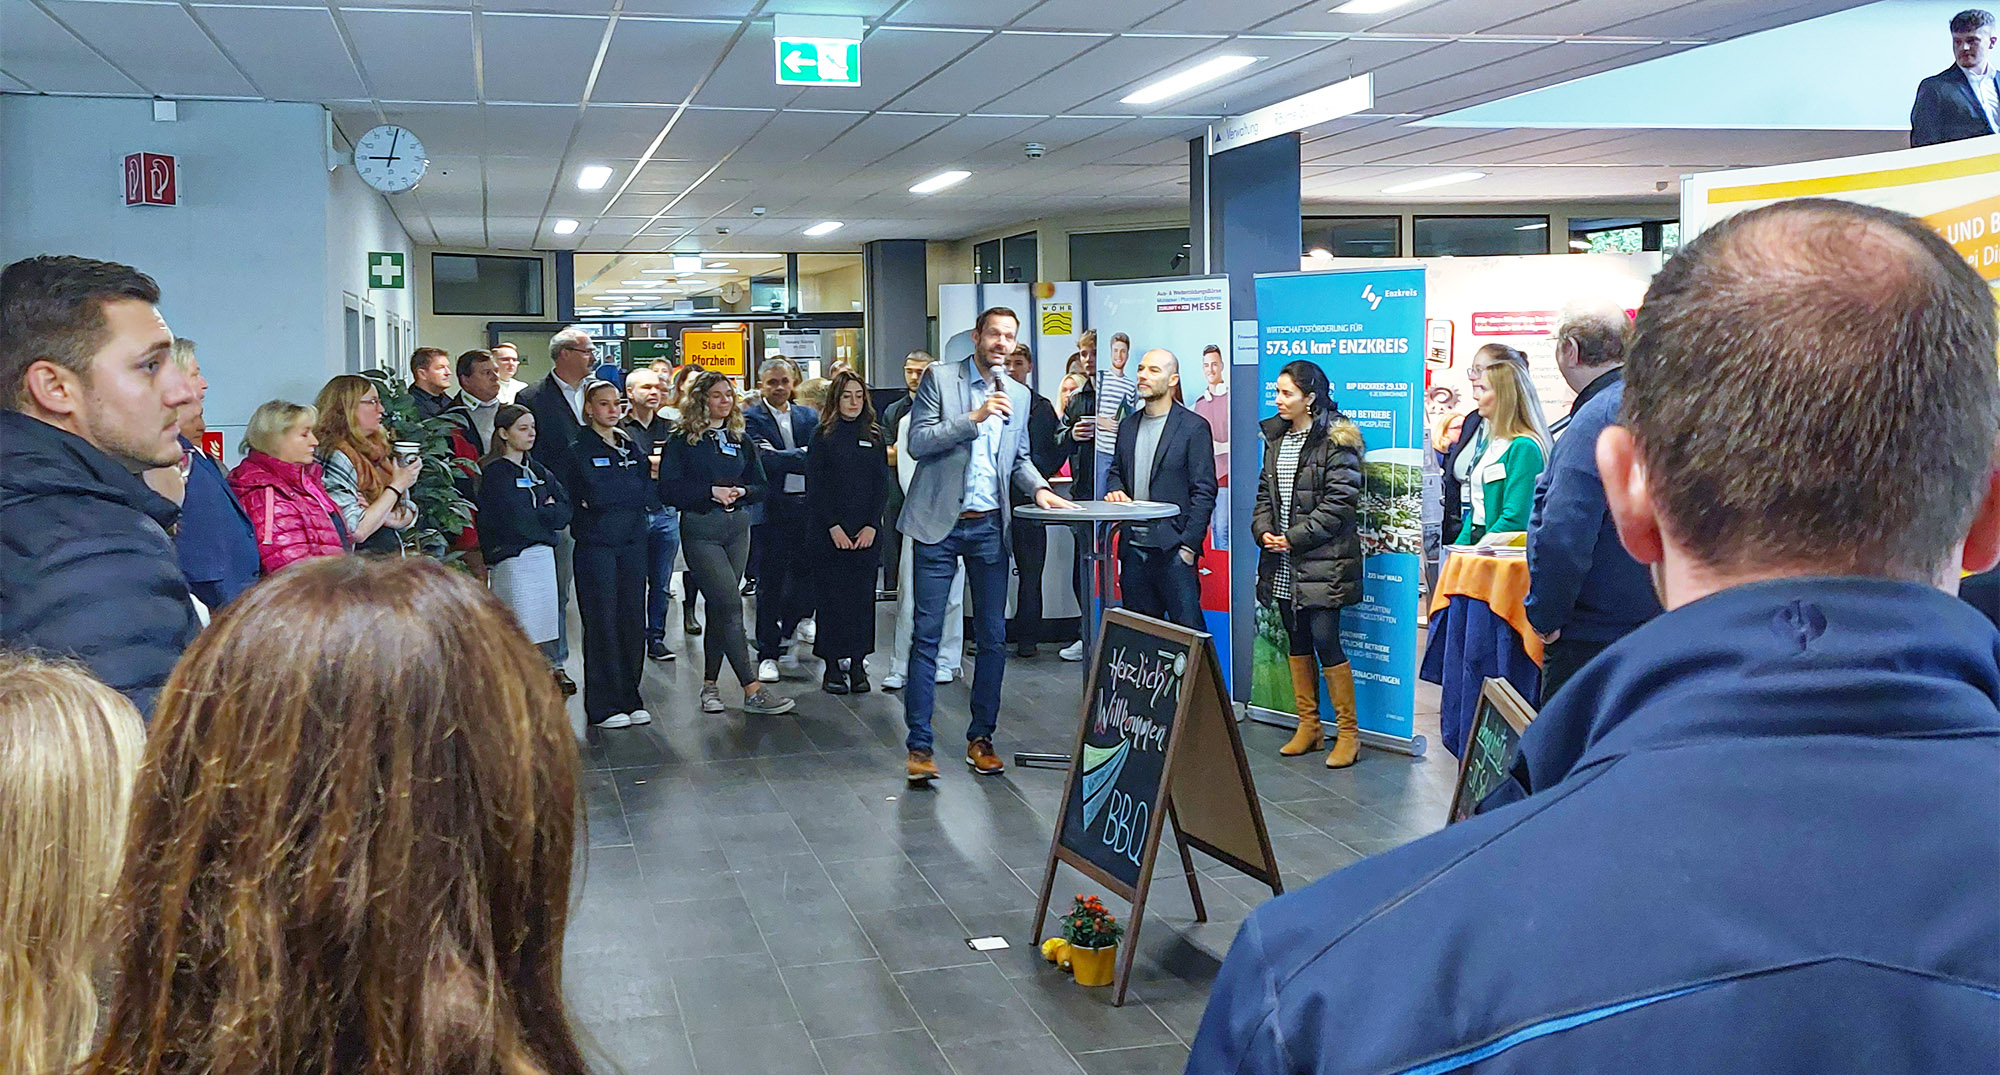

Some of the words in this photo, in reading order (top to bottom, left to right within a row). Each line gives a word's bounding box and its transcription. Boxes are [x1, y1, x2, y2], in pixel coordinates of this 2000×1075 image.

[1226, 121, 1258, 141] Verwaltung
[1947, 216, 1985, 245] UND
[1967, 249, 1979, 268] ei
[1384, 288, 1418, 298] Enzkreis
[1042, 302, 1072, 312] WÖHR
[1191, 302, 1222, 312] MESSE
[1266, 324, 1349, 334] WIRTSCHAFTSFÖRDERUNG
[1350, 323, 1363, 332] FÜR
[702, 340, 725, 350] Stadt
[1266, 340, 1308, 356] 573,61
[1310, 339, 1336, 354] km²
[1339, 338, 1408, 354] ENZKREIS
[692, 354, 735, 366] Pforzheim
[1358, 410, 1391, 419] BETRIEBE
[1363, 595, 1374, 603] LEN
[1364, 643, 1390, 653] BETRIEBE
[1108, 646, 1167, 708] Herzlich
[1352, 670, 1401, 685] ERNACHTUNGEN
[1094, 687, 1168, 752] Willkommen
[1102, 789, 1149, 867] BBQ
